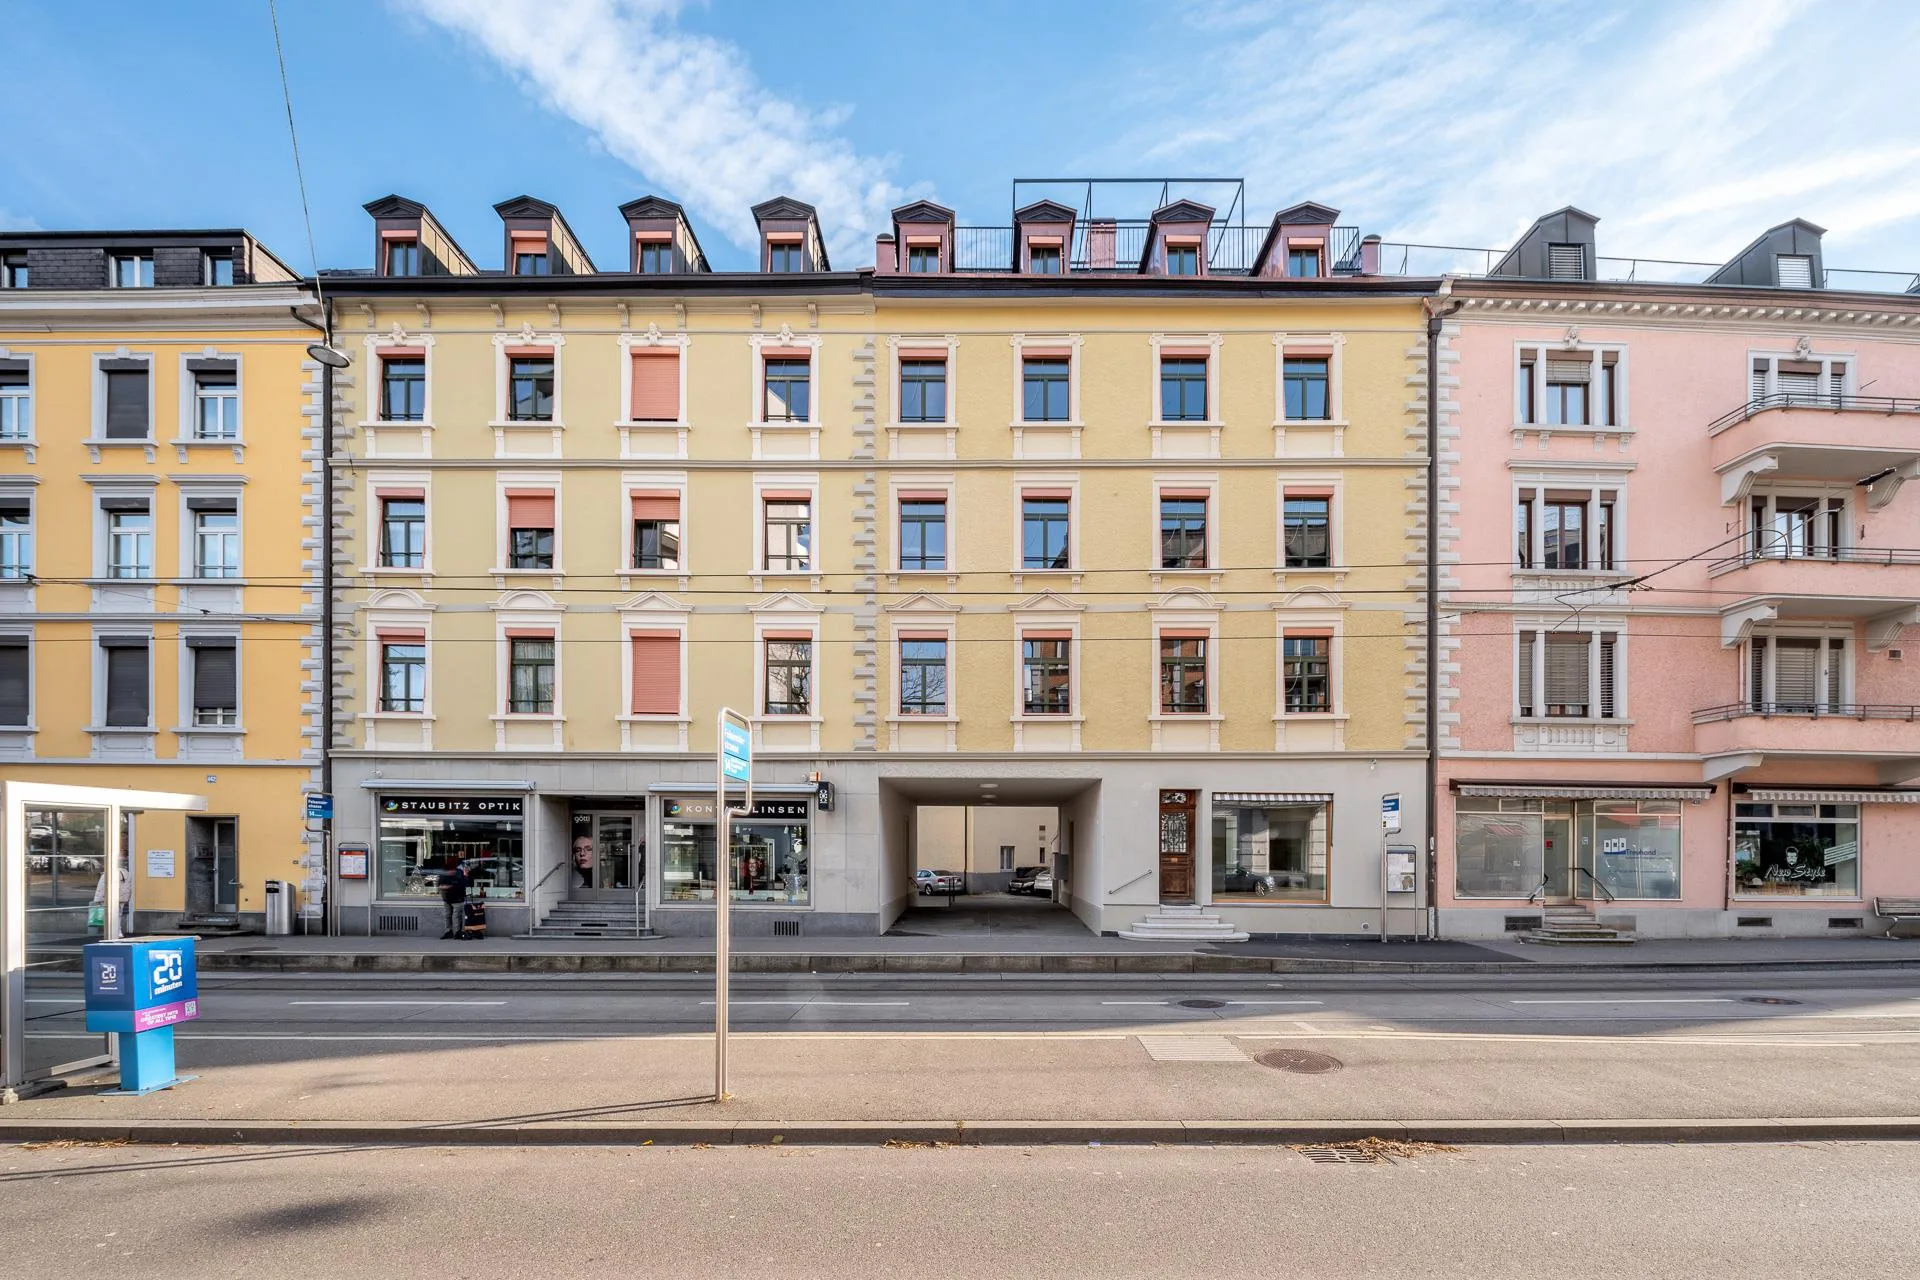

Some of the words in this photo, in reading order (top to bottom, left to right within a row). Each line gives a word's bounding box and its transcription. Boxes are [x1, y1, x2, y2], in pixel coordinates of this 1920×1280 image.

[401, 801, 470, 810] STAUBITZ
[478, 802, 520, 811] OPTIK
[686, 805, 805, 814] KONLINSEN
[1764, 863, 1791, 879] New
[1791, 864, 1826, 881] Style
[102, 965, 116, 979] 20
[153, 953, 182, 985] 20
[154, 981, 182, 995] minuten
